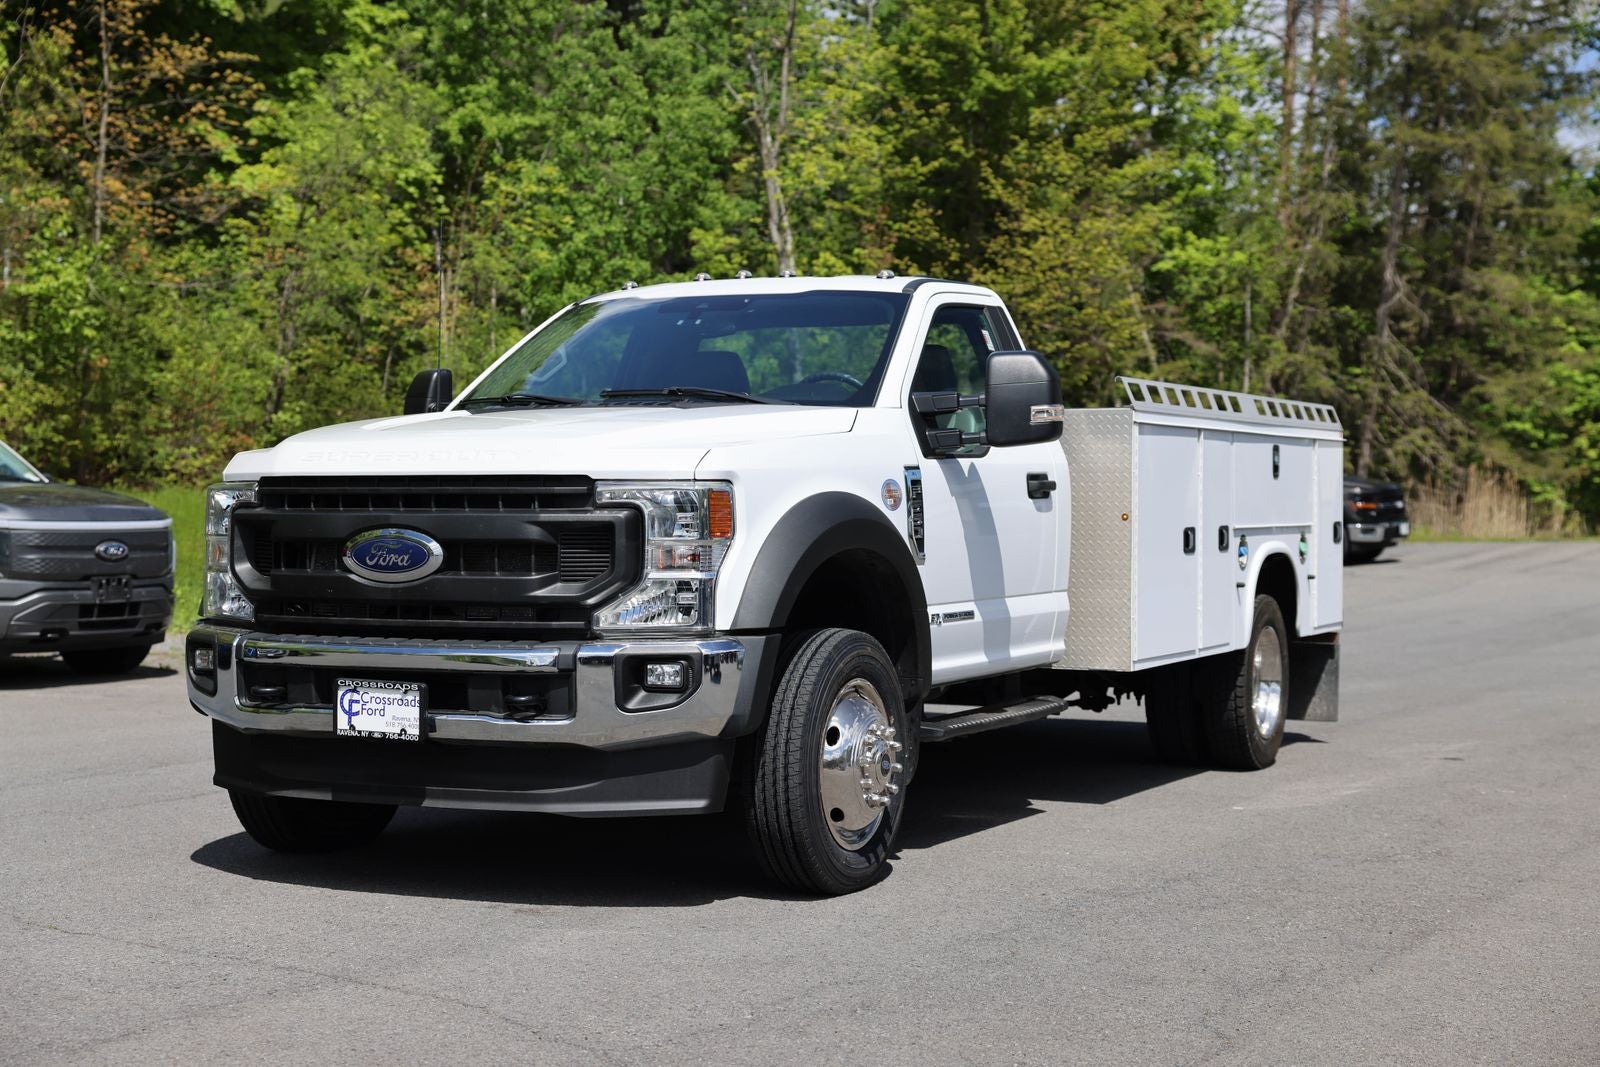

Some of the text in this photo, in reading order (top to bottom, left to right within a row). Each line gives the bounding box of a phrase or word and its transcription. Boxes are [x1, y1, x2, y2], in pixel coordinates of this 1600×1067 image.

[366, 540, 412, 566] Ford
[337, 679, 419, 691] CROSSROADS
[360, 691, 420, 708] Crossroads
[360, 704, 386, 717] Ford
